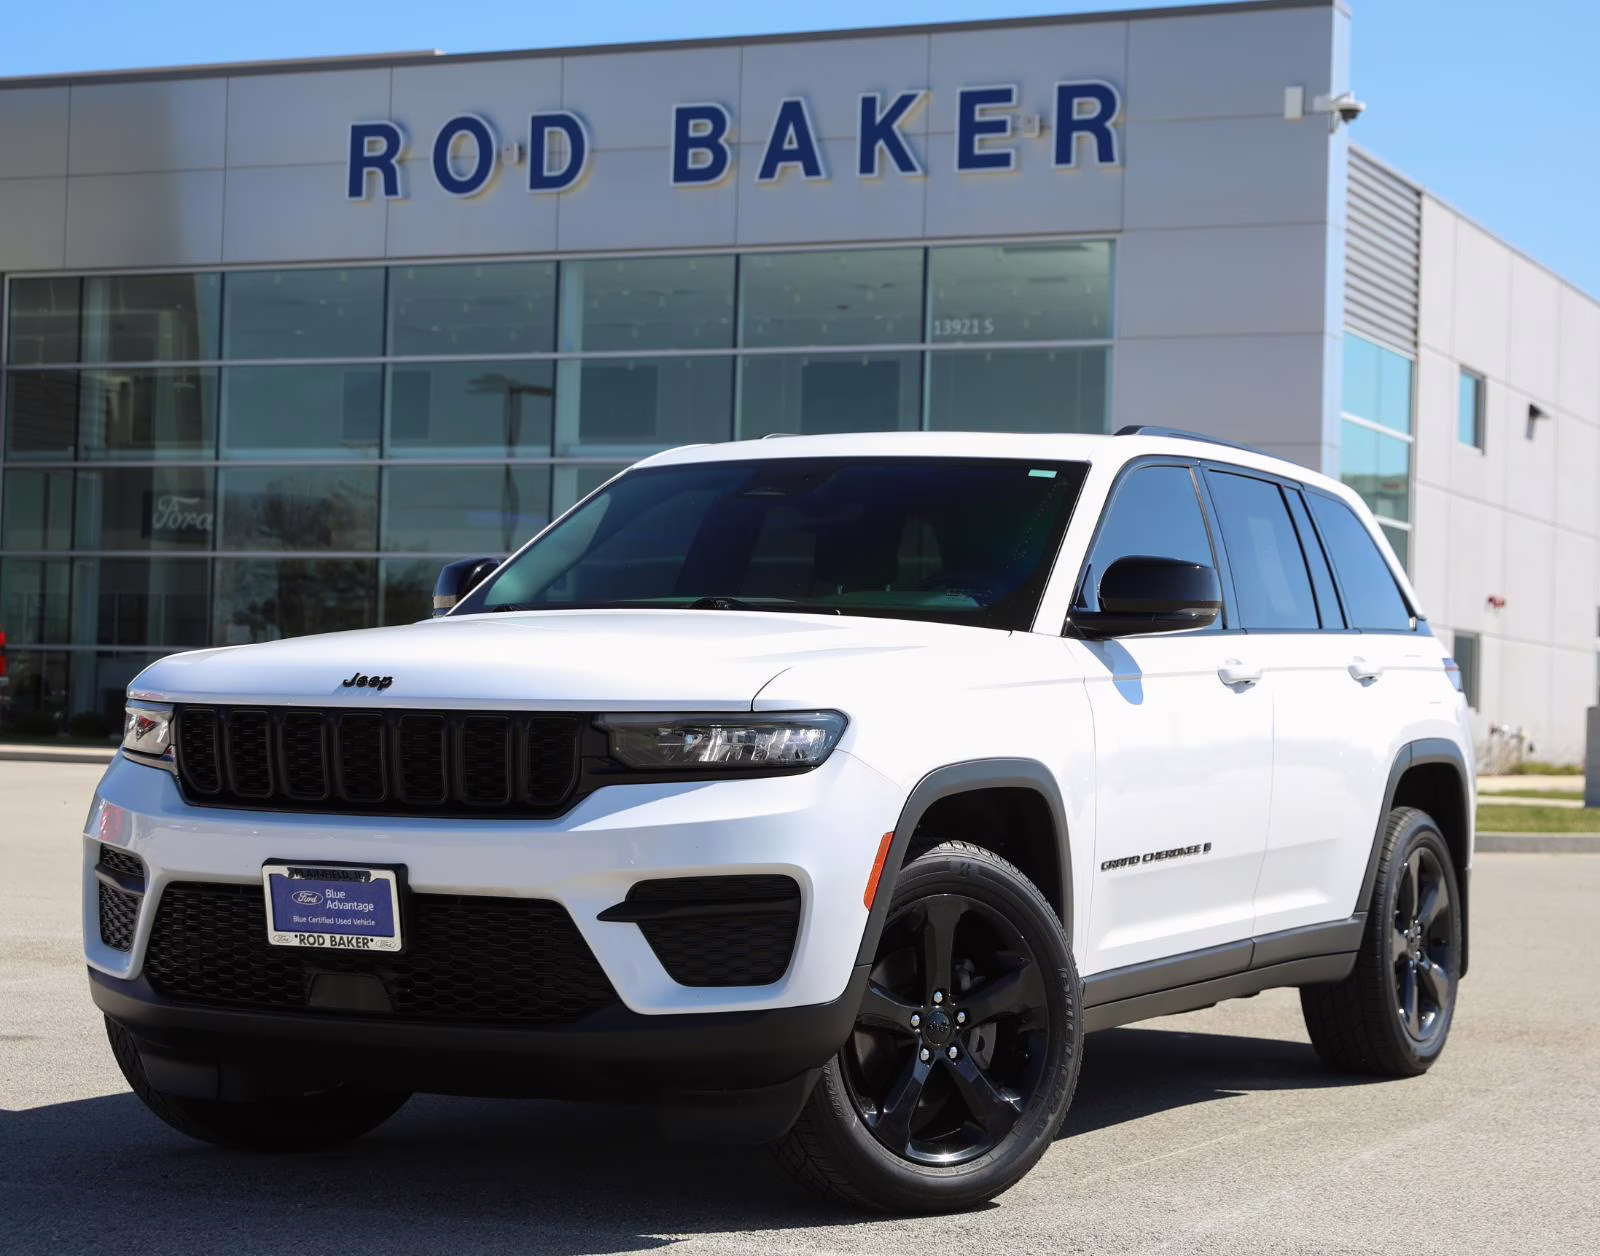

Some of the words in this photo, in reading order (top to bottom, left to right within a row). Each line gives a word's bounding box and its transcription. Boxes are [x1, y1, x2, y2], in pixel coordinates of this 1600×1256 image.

[348, 112, 588, 199] ROD
[671, 82, 1121, 186] BAKER
[933, 317, 979, 336] 13921
[983, 317, 994, 335] S
[342, 672, 393, 691] Jeep
[1100, 855, 1141, 871] GRAND
[1142, 844, 1202, 863] CHEROKEE
[296, 891, 319, 904] Ford
[325, 888, 346, 899] Blue
[326, 899, 375, 912] Advantage
[293, 915, 307, 923] Blue
[308, 916, 334, 924] Certified
[335, 917, 352, 925] Used
[352, 918, 376, 926] Vehicle
